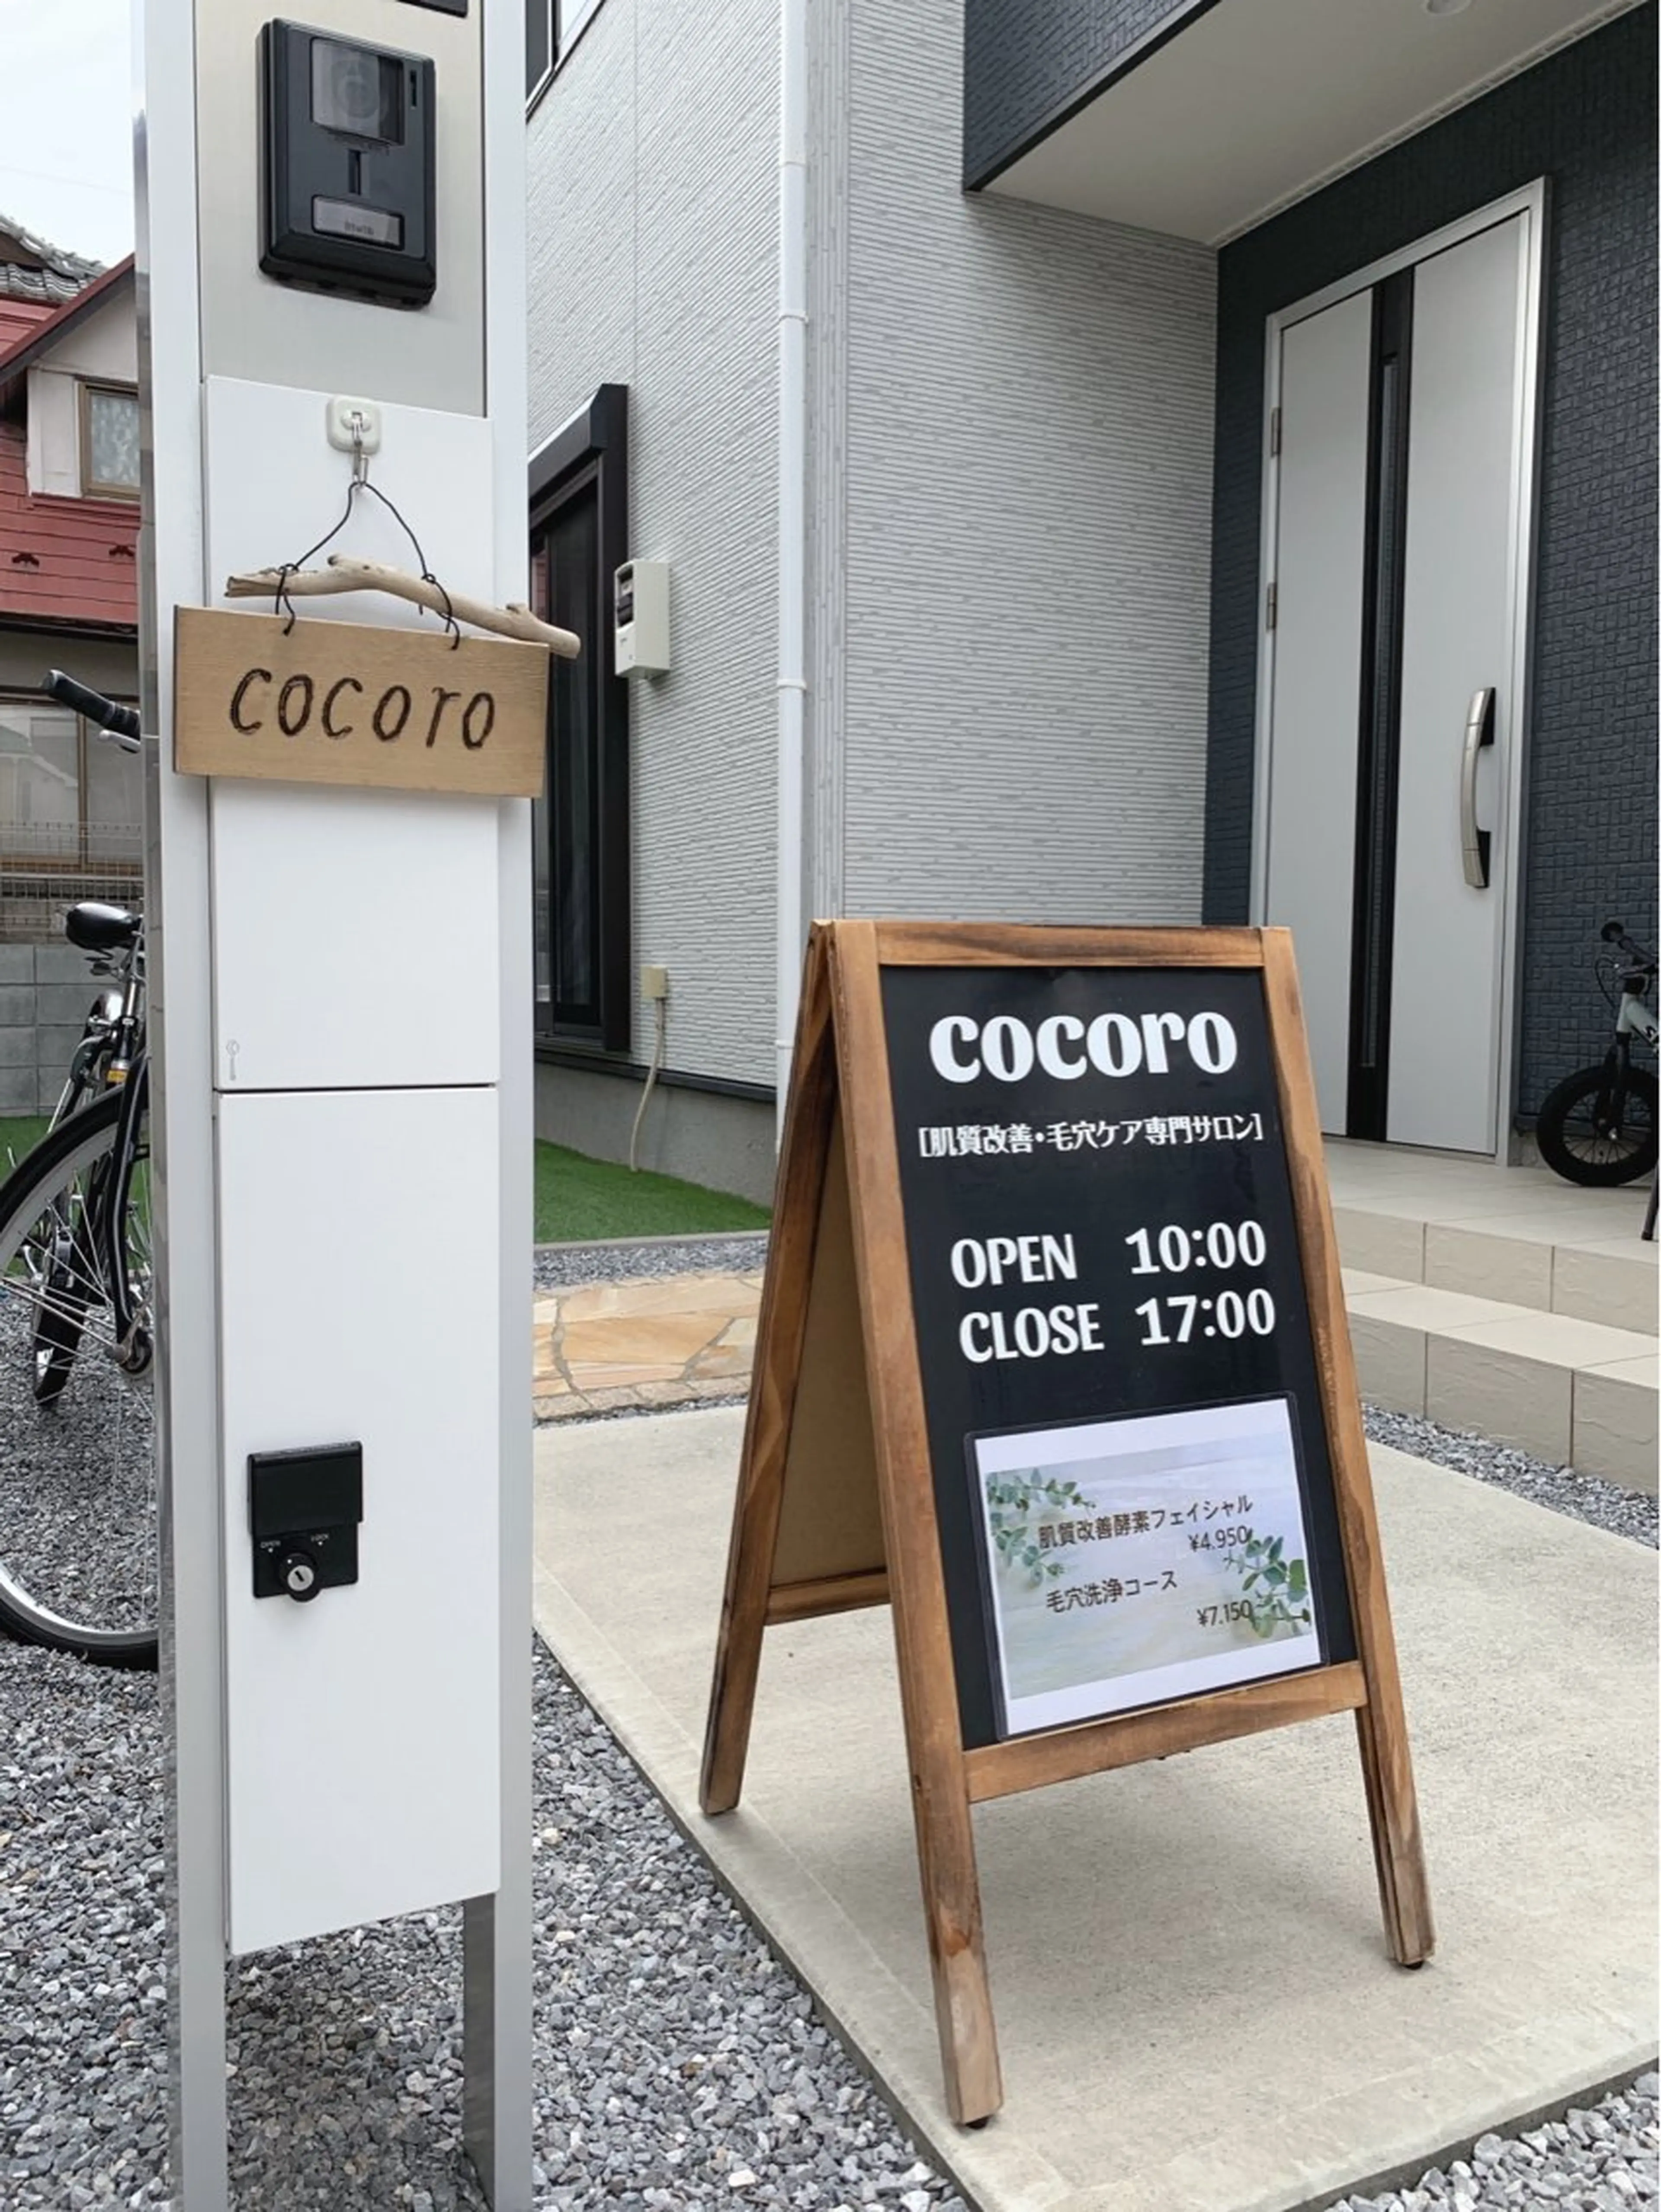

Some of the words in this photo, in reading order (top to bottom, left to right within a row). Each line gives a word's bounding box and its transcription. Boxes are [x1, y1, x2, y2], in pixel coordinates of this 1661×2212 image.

[229, 668, 495, 750] cocoro
[930, 1012, 1237, 1083] cocoro
[951, 1234, 1077, 1288] OPEN
[1125, 1221, 1266, 1274] 10:00
[960, 1304, 1104, 1362] CLOSE
[1135, 1289, 1275, 1345] 17:00
[1038, 1495, 1253, 1549] 肌質改善酵素フェイシャル
[1046, 1570, 1178, 1613] 毛穴洗浄コース
